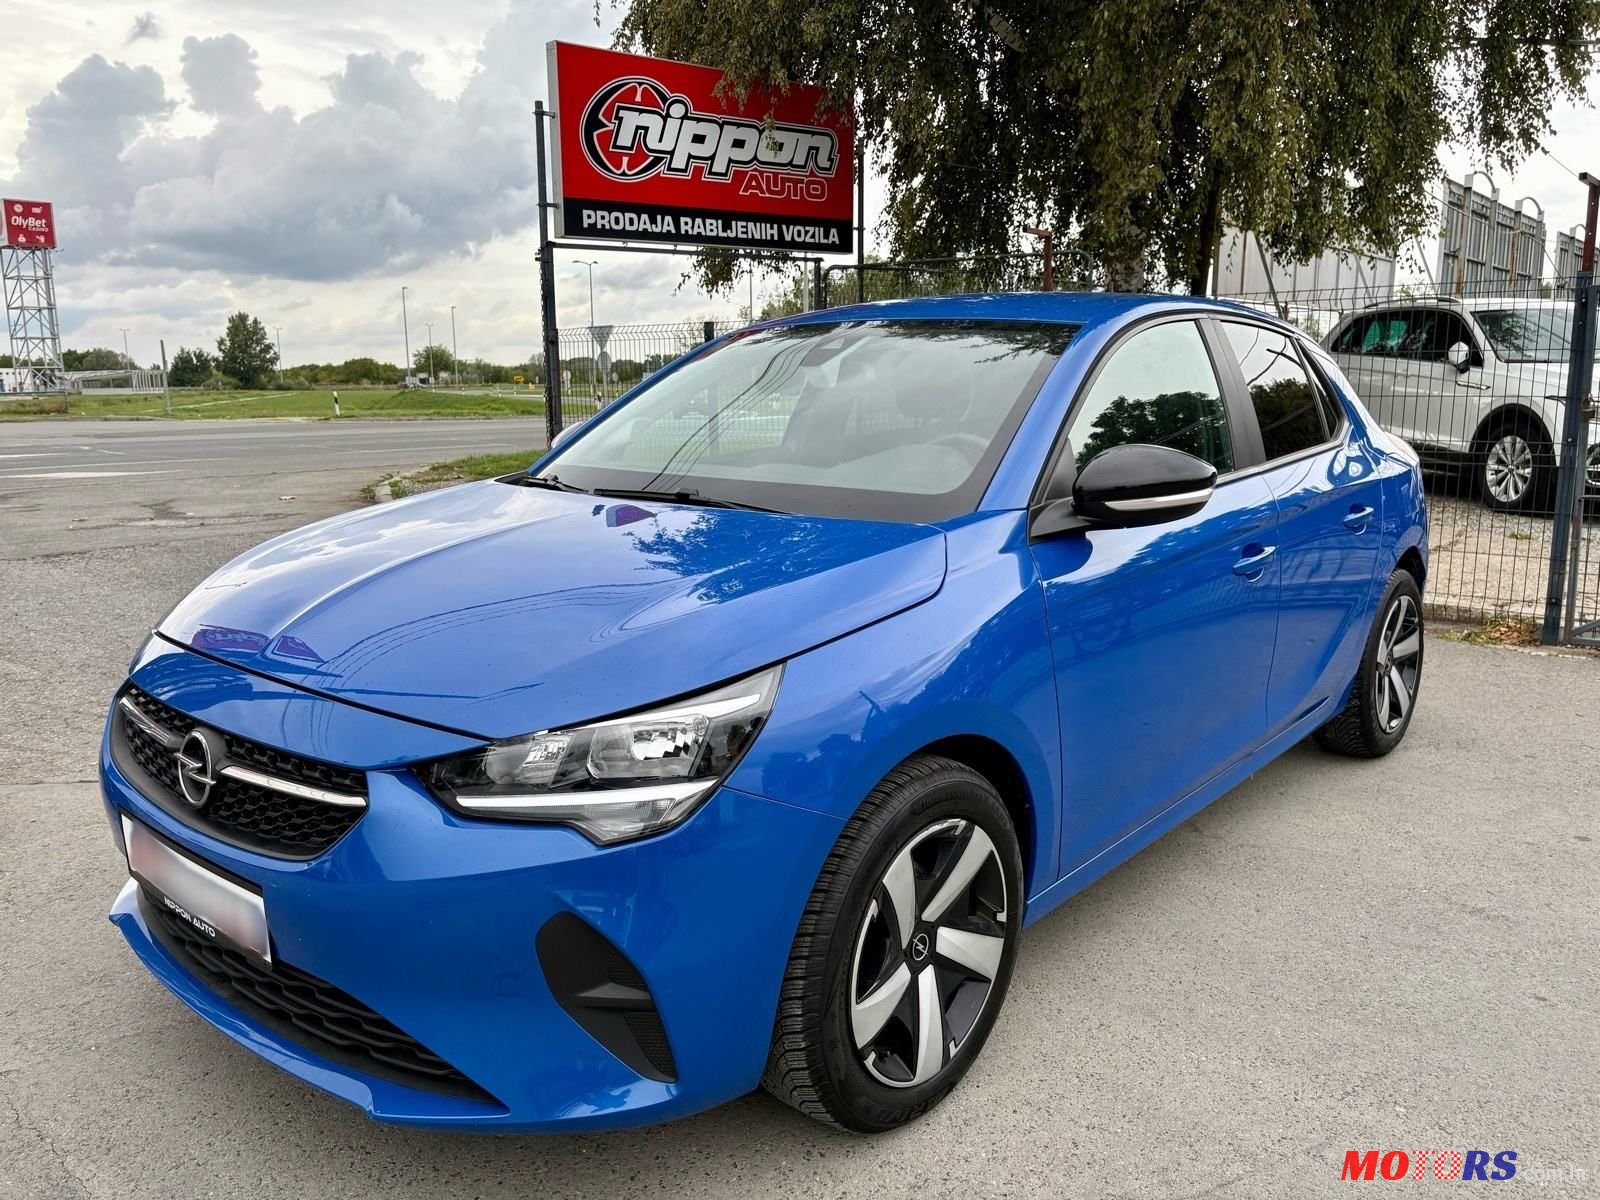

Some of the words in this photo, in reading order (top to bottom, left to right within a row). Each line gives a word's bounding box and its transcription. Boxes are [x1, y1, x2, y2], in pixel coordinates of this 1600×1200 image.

[613, 100, 836, 175] nippon
[739, 171, 828, 202] AUTO
[11, 215, 47, 229] OlyBet
[582, 209, 677, 234] PRODAJA
[680, 216, 779, 241] RABLJENIH
[781, 224, 840, 245] VOZILA
[163, 896, 192, 922] NIPPON
[193, 917, 216, 938] AUTO
